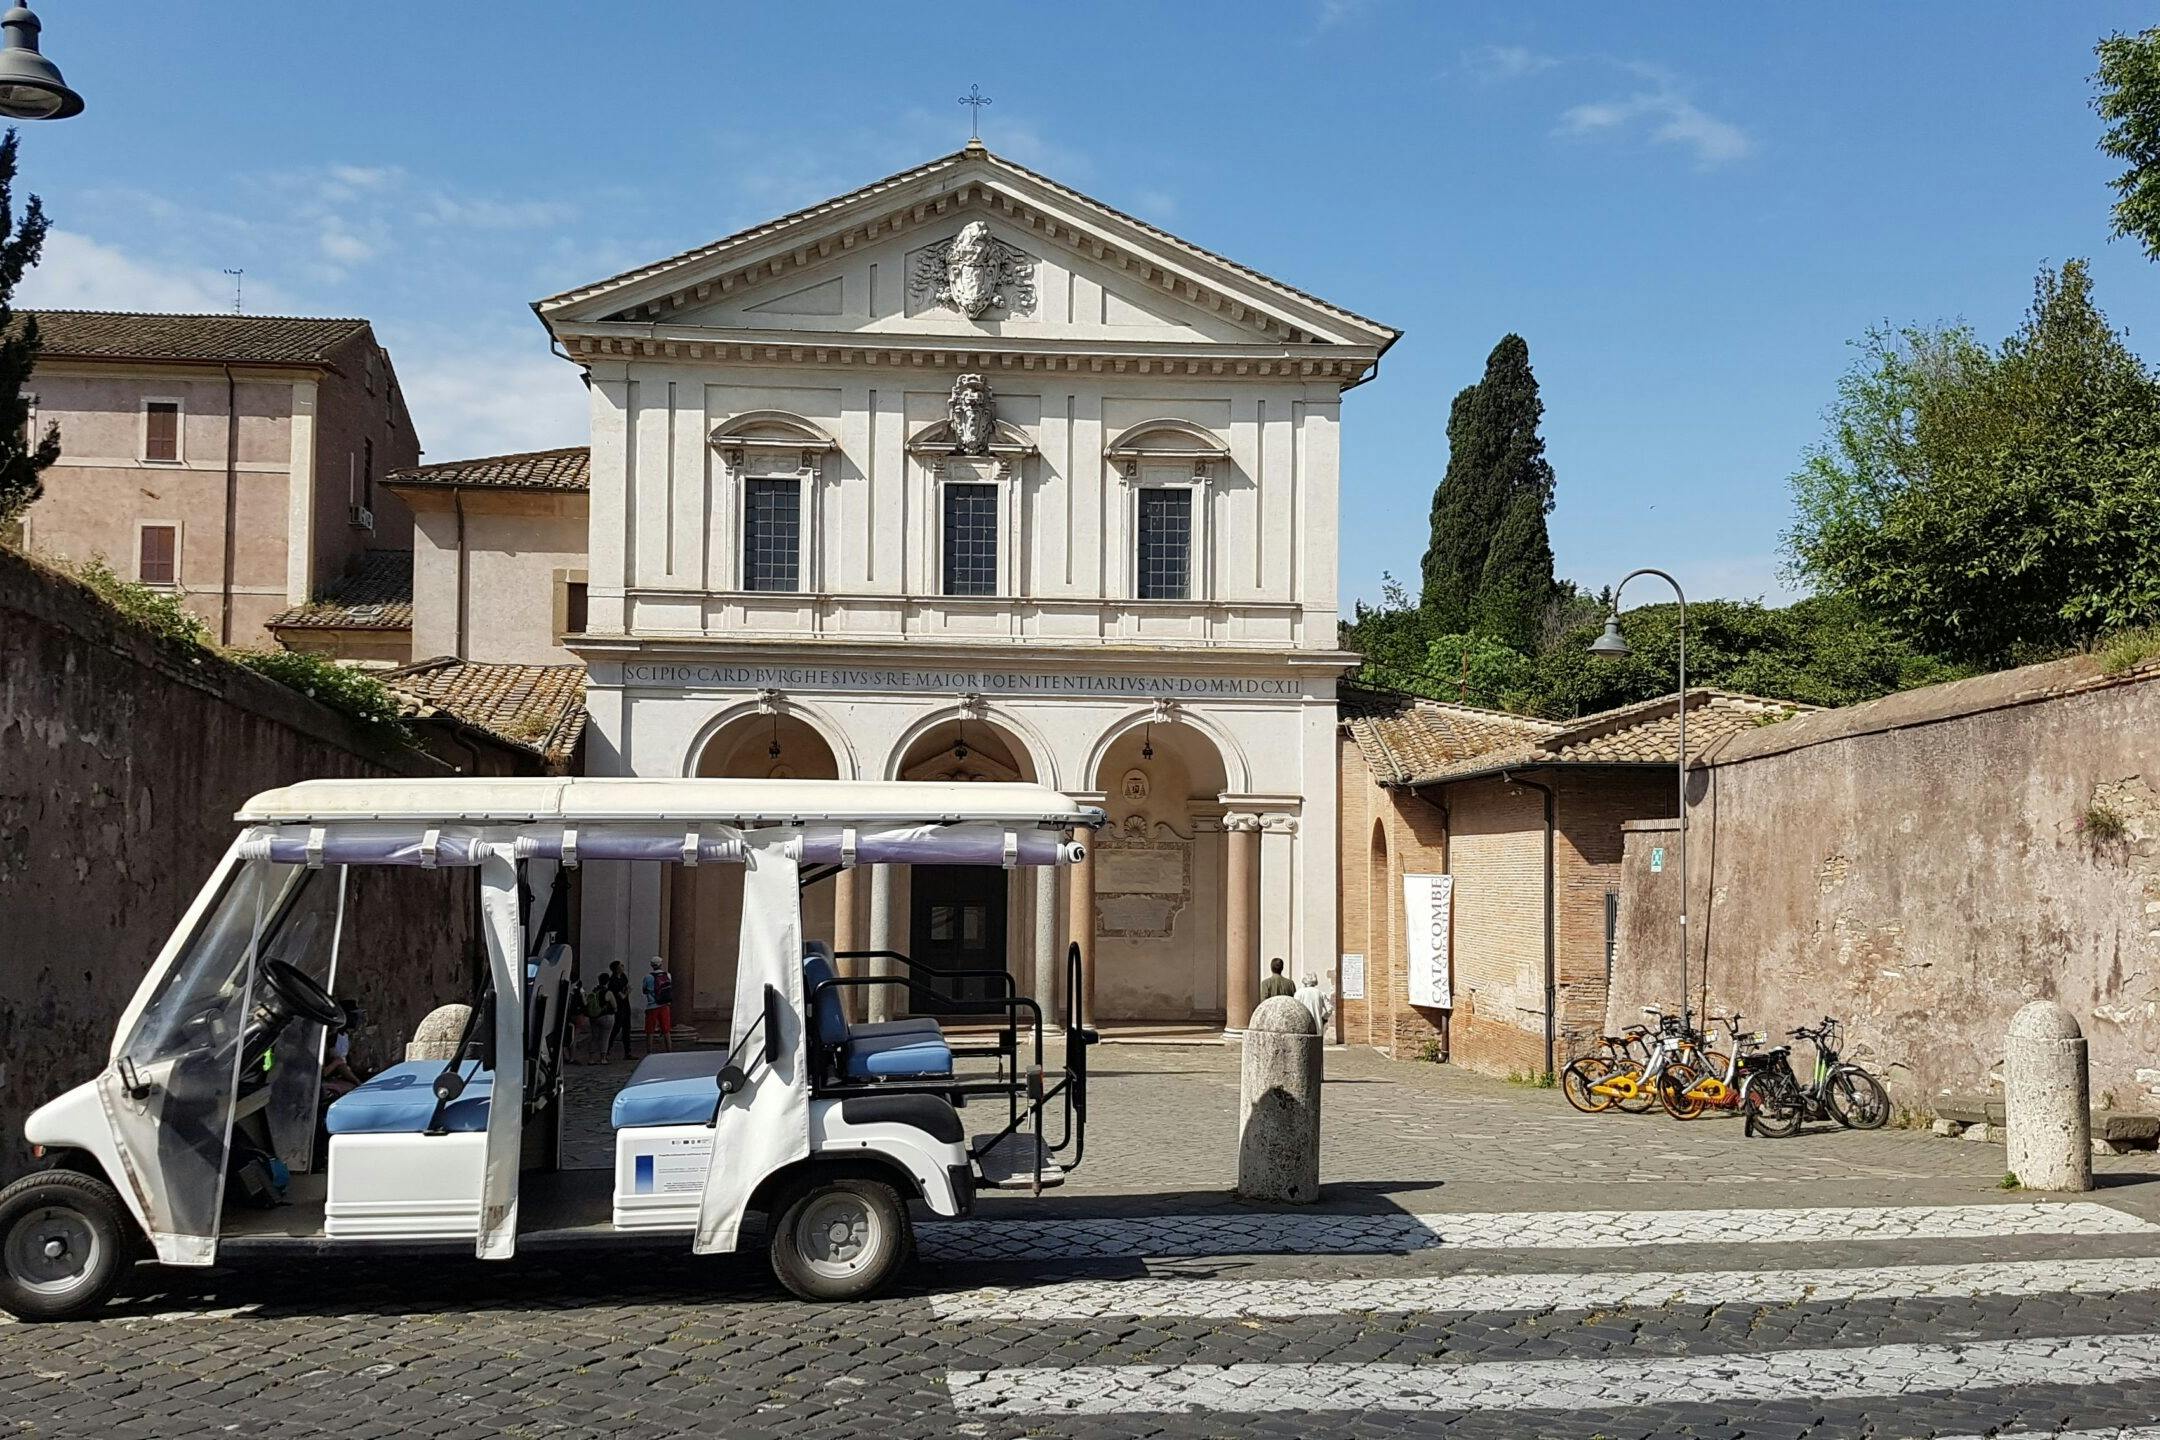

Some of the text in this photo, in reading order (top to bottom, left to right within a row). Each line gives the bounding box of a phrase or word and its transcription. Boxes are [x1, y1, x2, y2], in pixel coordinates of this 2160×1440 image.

[626, 666, 691, 681] SCIPIO
[697, 667, 750, 682] CARD
[755, 669, 868, 685] BVRGHESIVS
[915, 672, 978, 687] MAIOR
[982, 674, 1145, 691] POENITENTIARIVS
[1150, 678, 1174, 691] AN
[1179, 678, 1224, 692] DOM
[1229, 679, 1300, 694] MDCXII
[1431, 878, 1442, 1004] CATACOMBE
